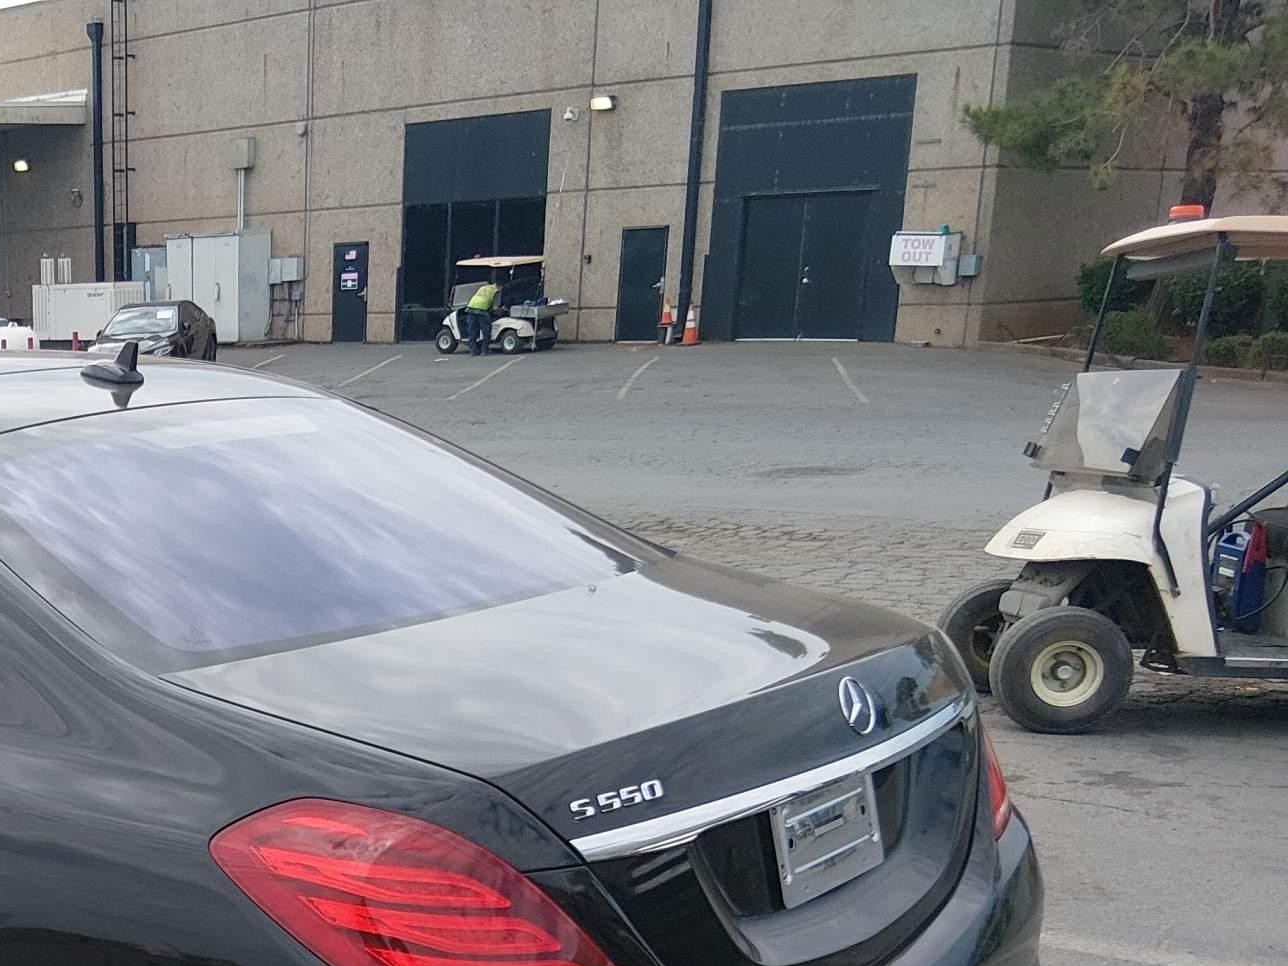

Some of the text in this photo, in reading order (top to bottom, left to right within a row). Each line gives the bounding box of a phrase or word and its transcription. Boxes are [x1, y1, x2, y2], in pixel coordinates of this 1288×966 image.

[902, 238, 936, 250] TOW
[902, 251, 933, 263] OUT
[569, 779, 664, 820] S 550
